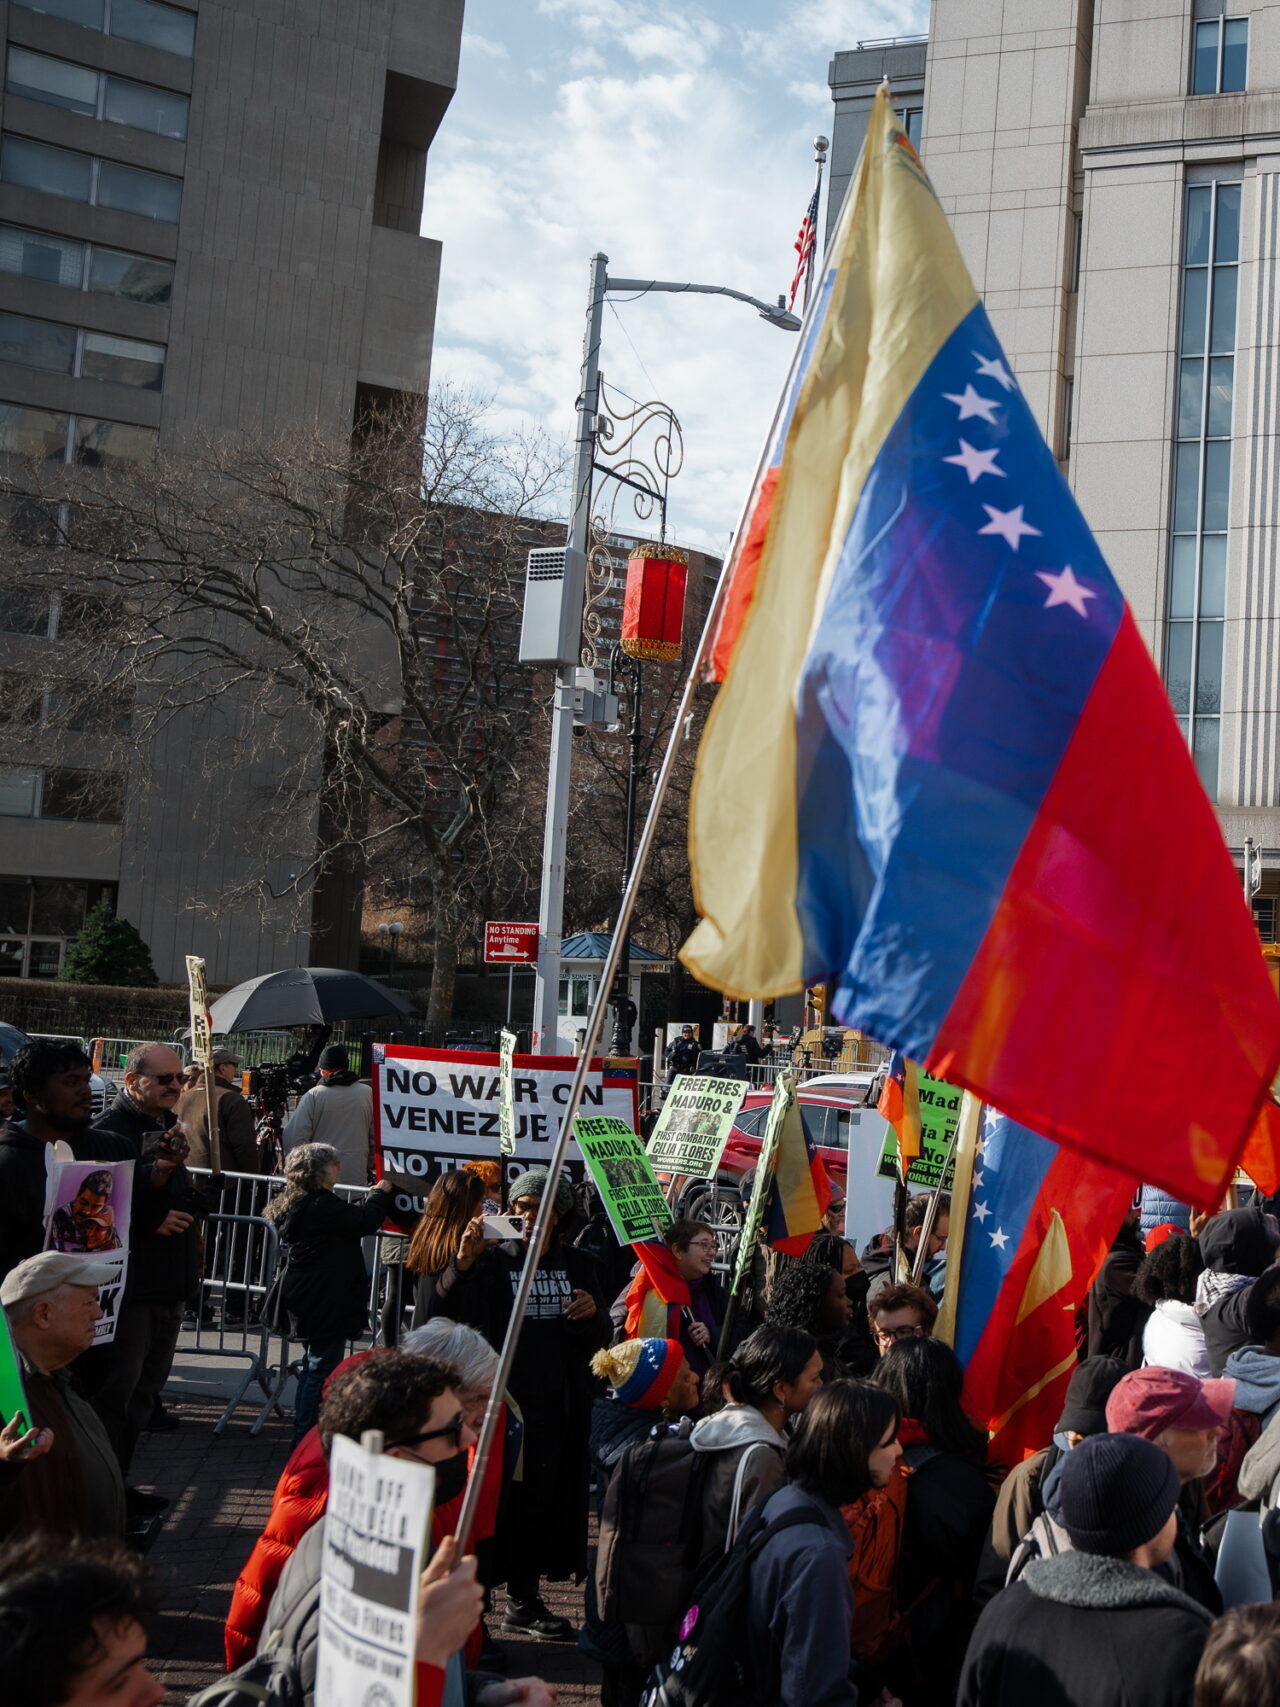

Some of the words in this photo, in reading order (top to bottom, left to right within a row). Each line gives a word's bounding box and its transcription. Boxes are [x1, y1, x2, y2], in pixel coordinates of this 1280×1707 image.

[489, 926, 500, 935] NO
[501, 927, 536, 936] STANDING
[489, 936, 519, 944] Anytime
[386, 1068, 437, 1096] NO
[449, 1073, 538, 1103] WAR
[552, 1083, 604, 1106] ON
[677, 1077, 708, 1092] FREE
[707, 1080, 742, 1098] PRES.
[669, 1095, 721, 1113] MADURO
[722, 1100, 733, 1115] &
[918, 1088, 960, 1111] Mad
[576, 1118, 608, 1138] FREE
[655, 1130, 676, 1143] FIRST
[676, 1132, 722, 1148] COMBATANT
[585, 1139, 631, 1160] MADURO
[630, 1139, 643, 1157] &
[652, 1142, 677, 1156] CILIA
[677, 1145, 716, 1162] FLORES
[383, 1150, 428, 1177] NO
[656, 1156, 704, 1168] WORKERS.ORG
[609, 1187, 629, 1202] FIRST
[616, 1202, 643, 1219] CILIA
[643, 1198, 669, 1216] FLORES
